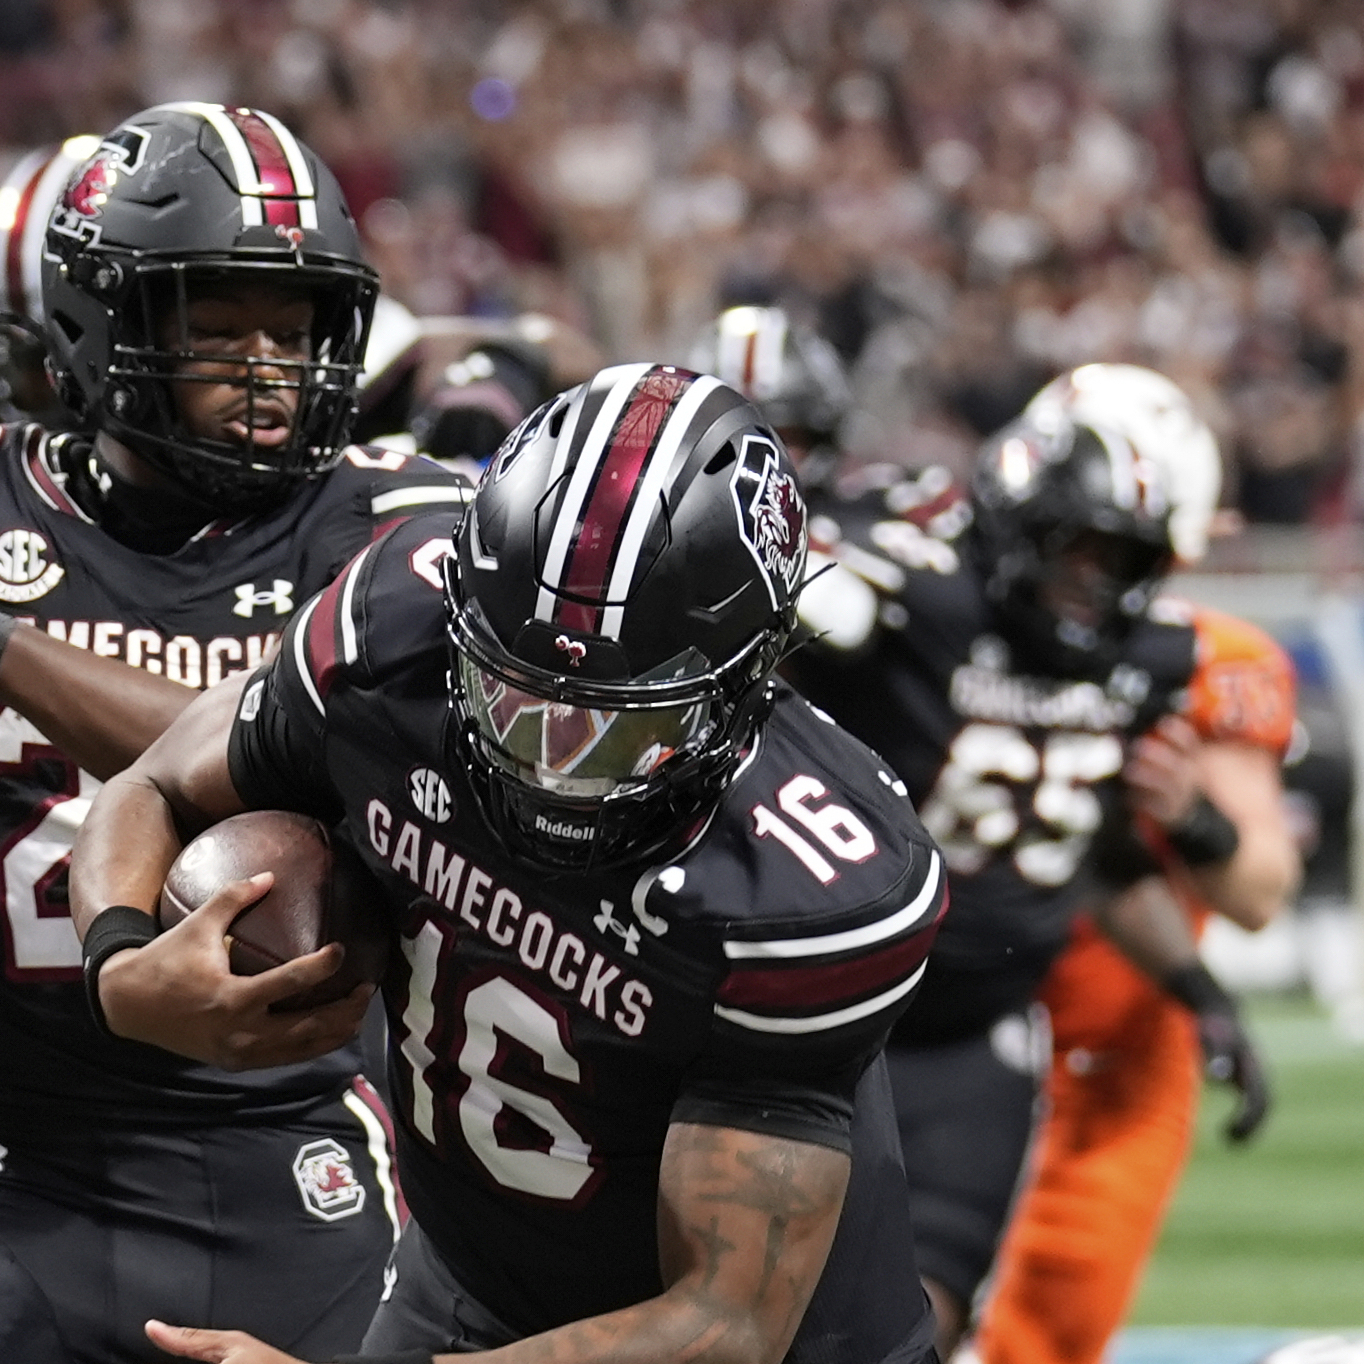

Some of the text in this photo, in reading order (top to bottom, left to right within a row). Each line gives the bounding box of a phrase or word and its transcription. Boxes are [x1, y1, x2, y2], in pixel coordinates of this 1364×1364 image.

[409, 767, 453, 824] SEC
[535, 814, 596, 841] Riddell
[749, 773, 880, 887] 16
[366, 798, 654, 1037] GAMECOCKS
[396, 914, 597, 1203] 16
